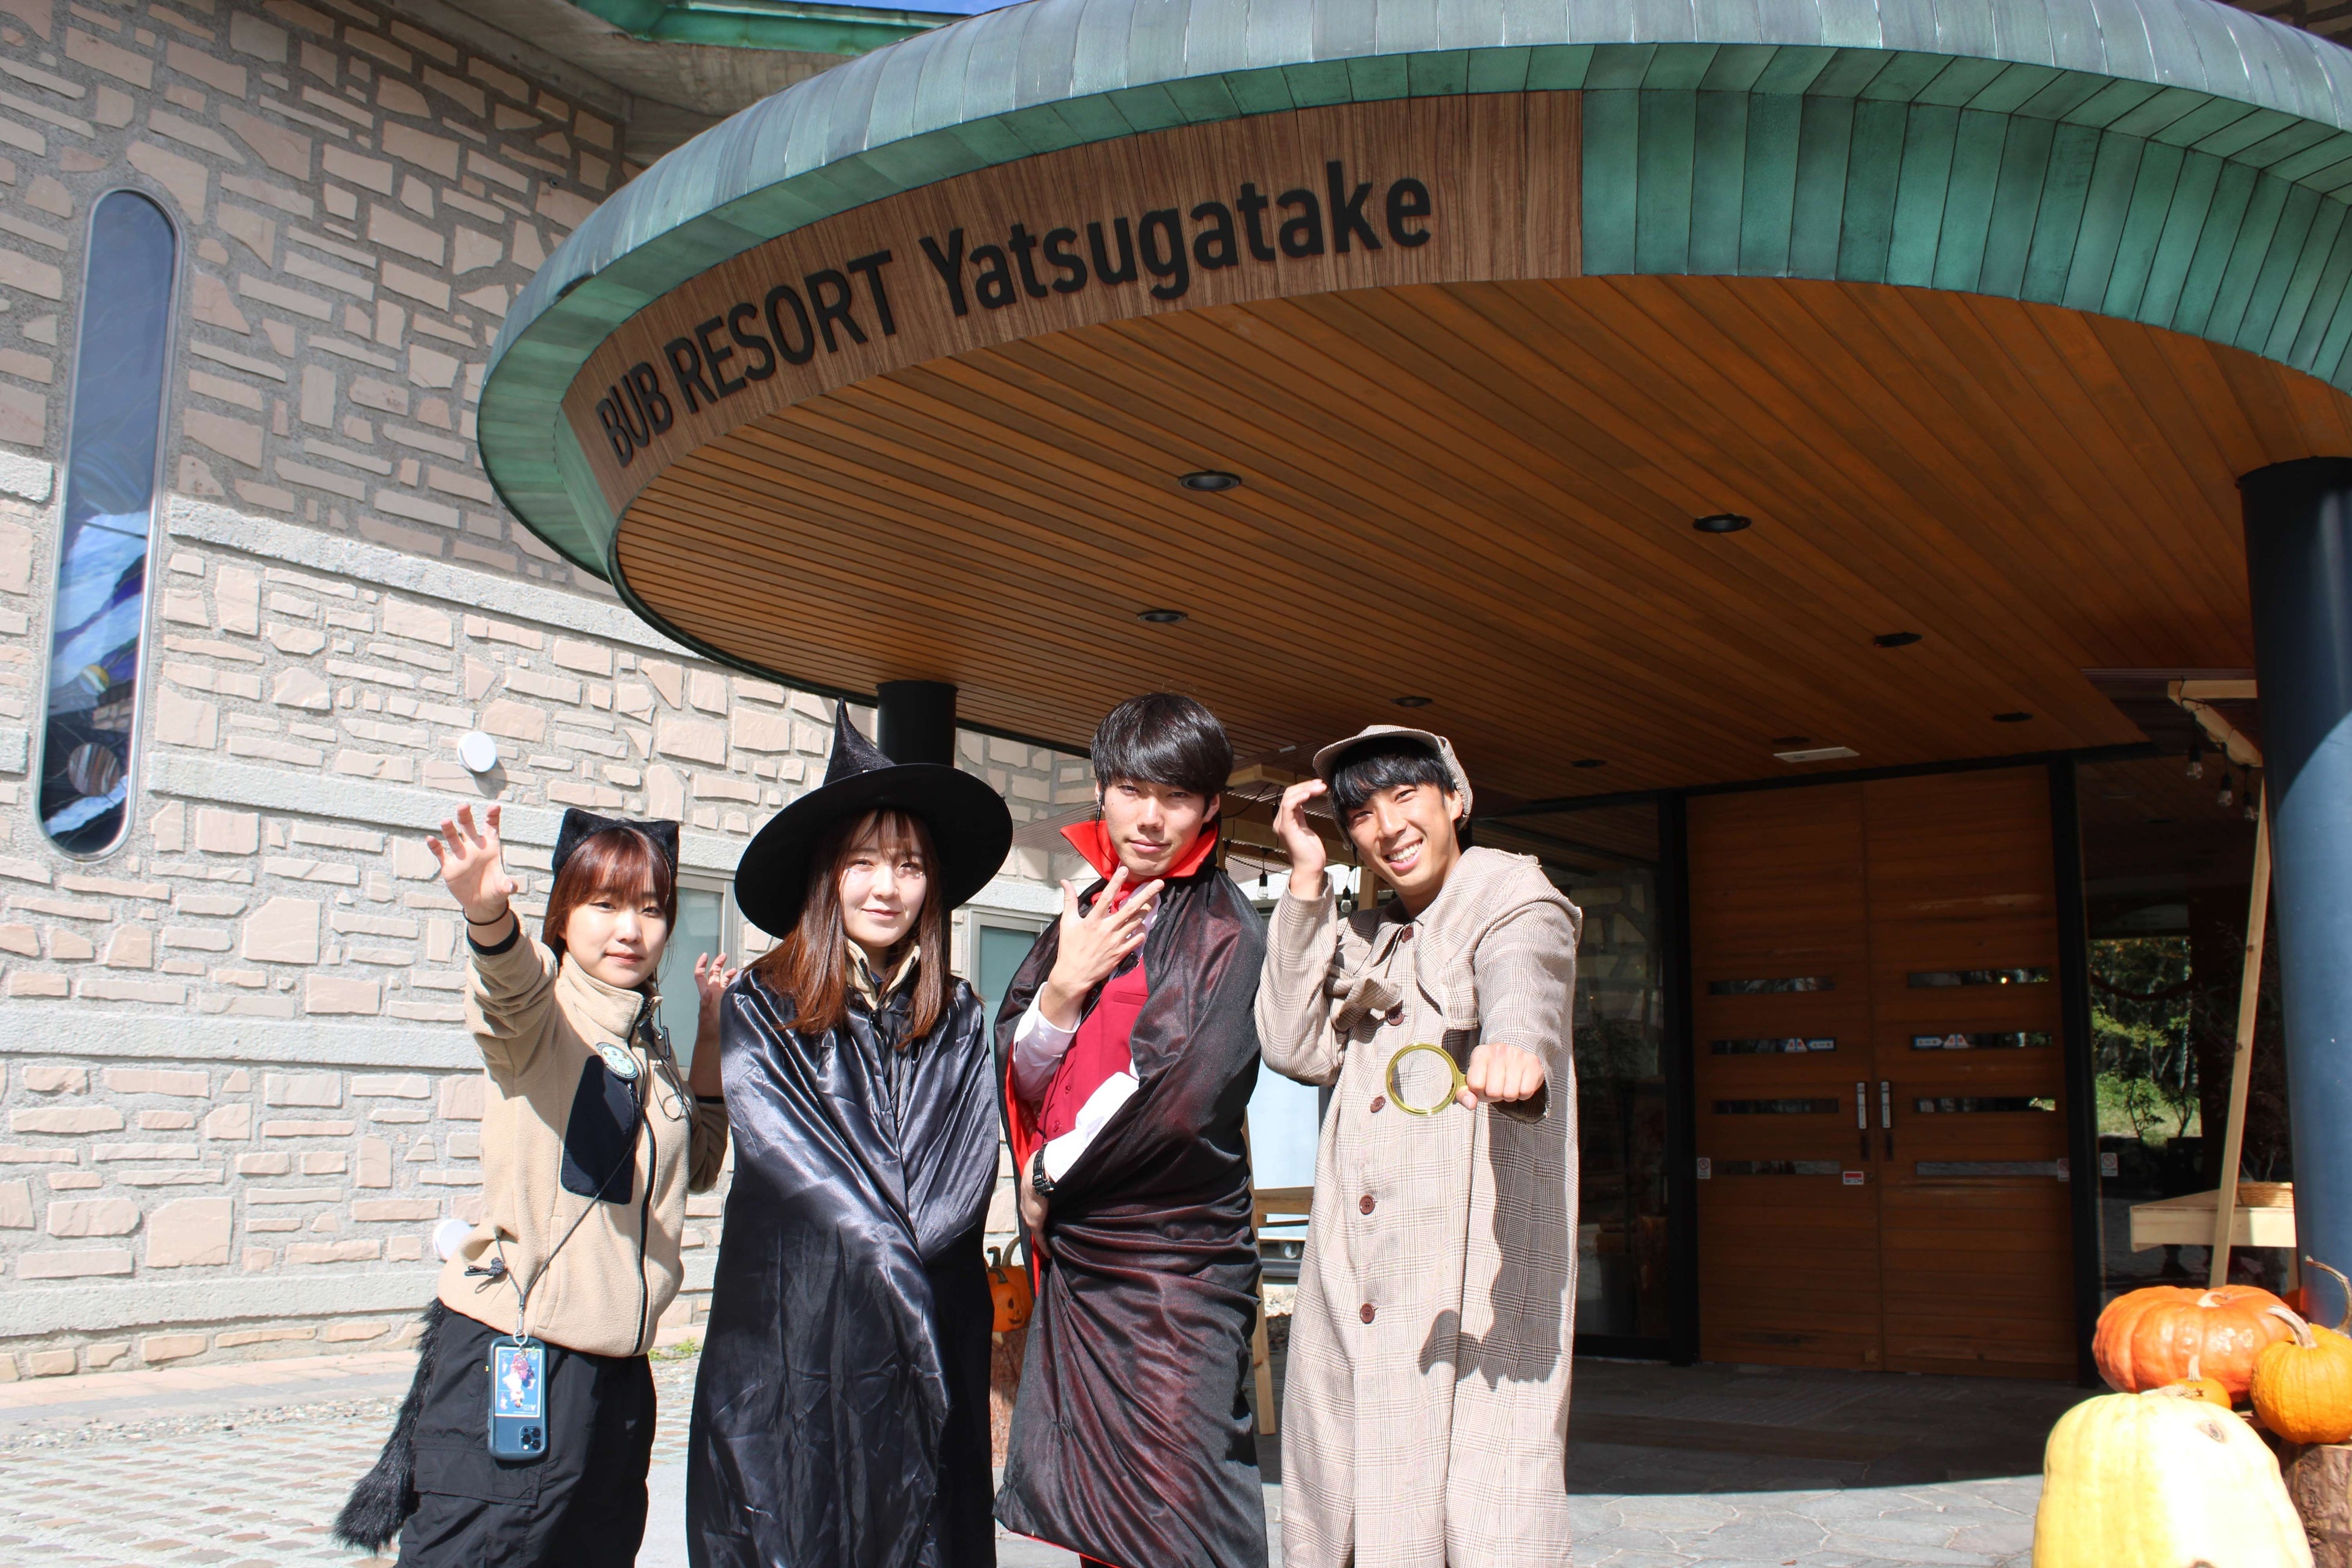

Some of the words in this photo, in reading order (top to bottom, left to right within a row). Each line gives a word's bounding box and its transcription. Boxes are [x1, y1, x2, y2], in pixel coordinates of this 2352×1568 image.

[595, 362, 674, 468] BUB
[663, 249, 896, 414] RESORT
[918, 160, 1432, 317] Yatsugatake
